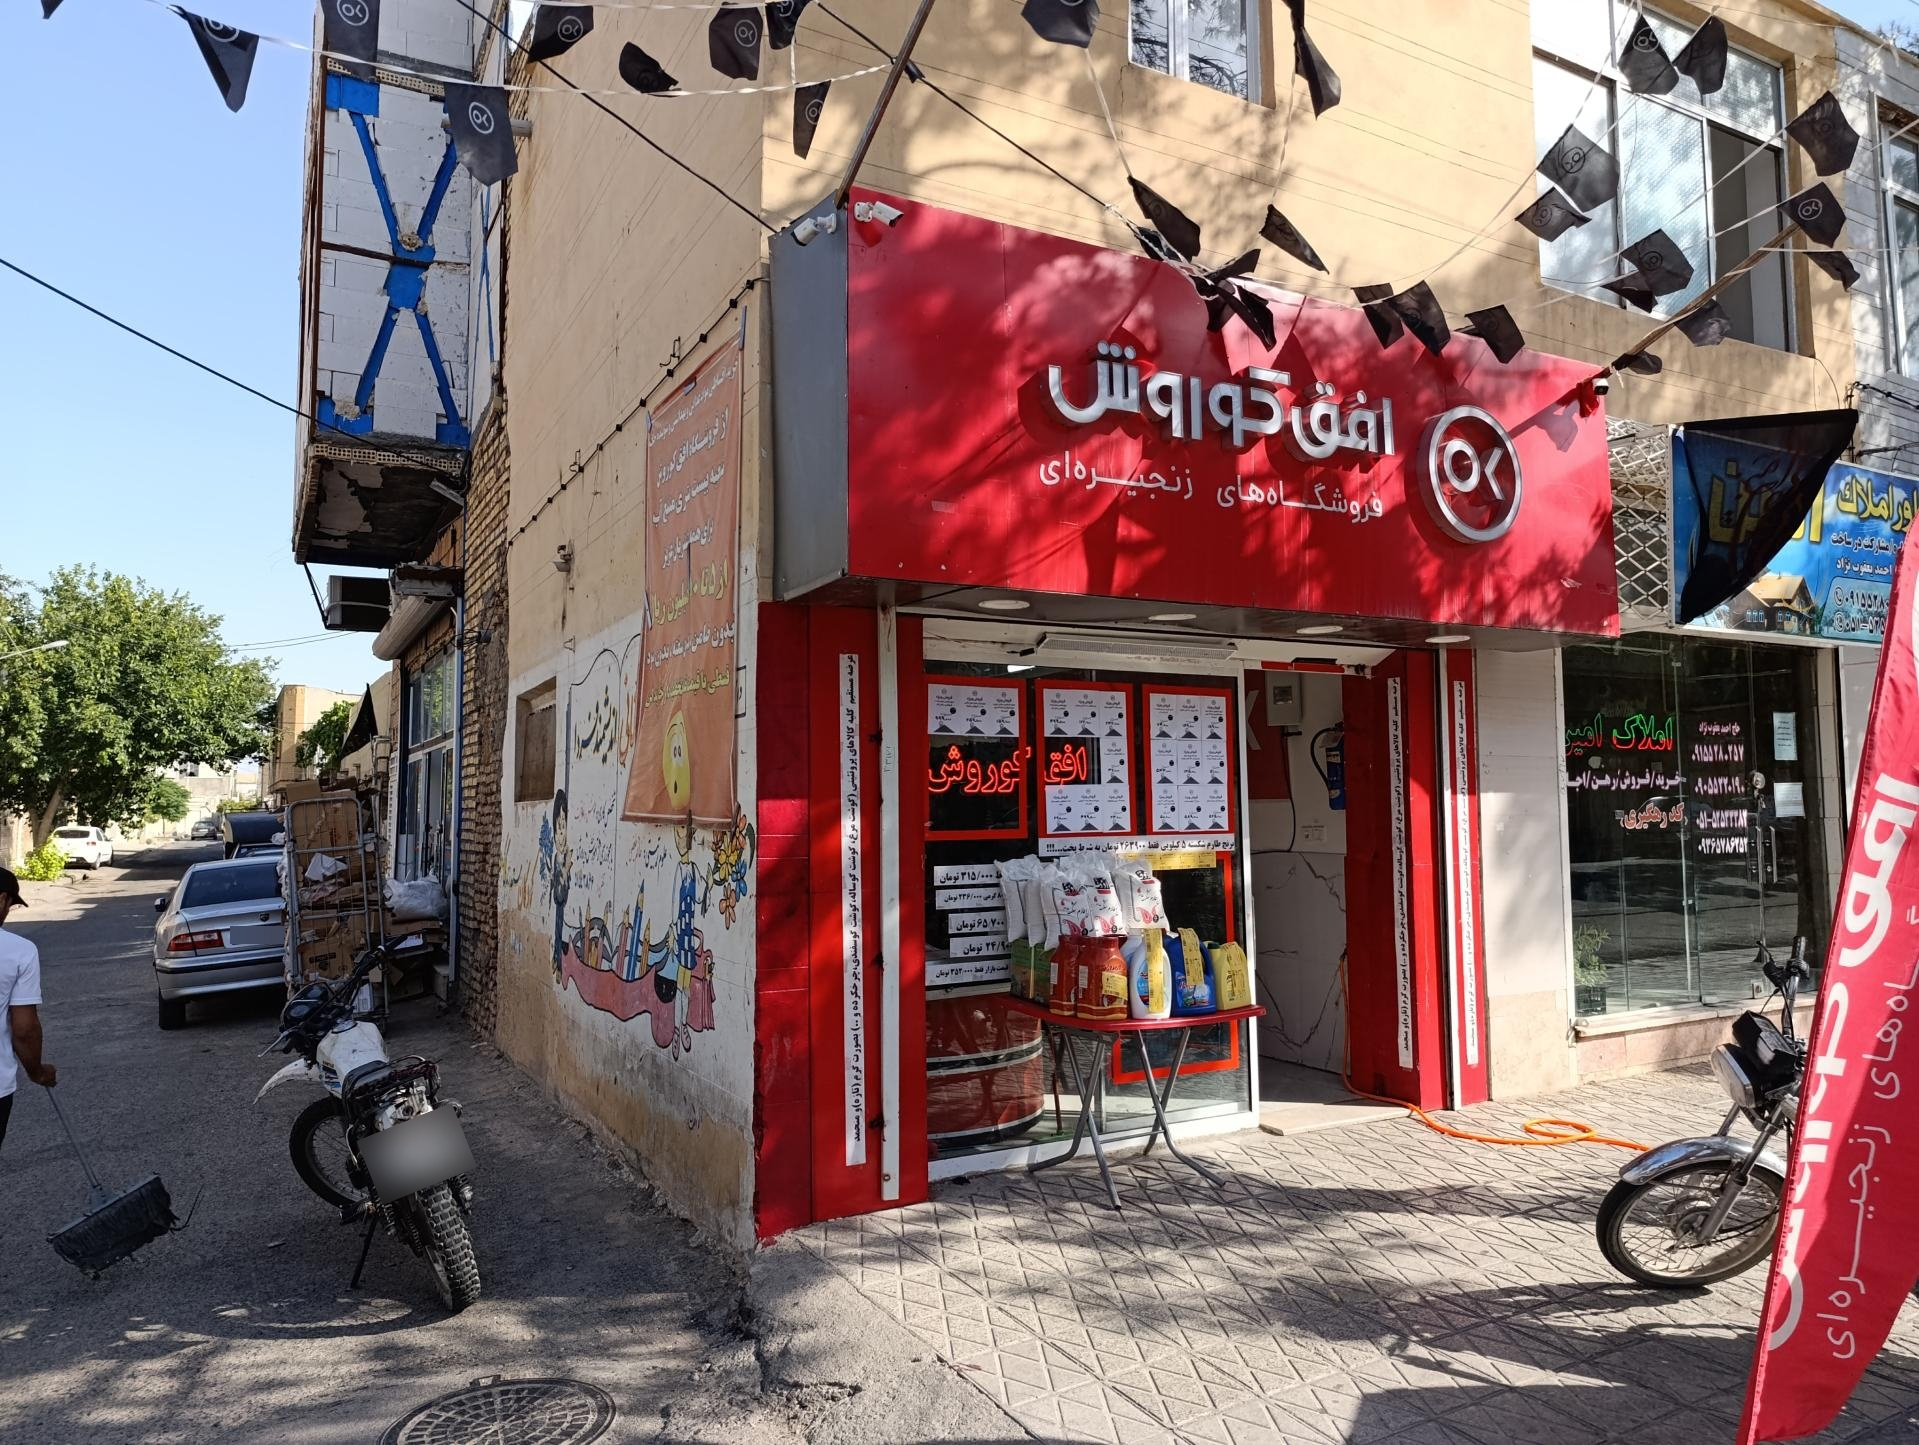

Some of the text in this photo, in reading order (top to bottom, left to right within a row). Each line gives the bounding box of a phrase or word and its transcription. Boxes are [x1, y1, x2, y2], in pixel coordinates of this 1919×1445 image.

[472, 109, 490, 127] OK
[1048, 340, 1395, 460] افق کوروش
[1039, 450, 1384, 525] فروشگاه‌های زنجیره‌ای
[1831, 531, 1852, 548] ساخت
[1836, 556, 1851, 575] نژاد
[846, 656, 856, 676] عرضه
[846, 678, 856, 704] مستقیم
[846, 708, 855, 723] کلیه
[846, 726, 856, 755] کالاهای
[1612, 713, 1674, 751] املاک
[1393, 734, 1401, 756] کالاهای
[1692, 744, 1744, 762] ۰۹۱۵۵۲۸۰۲۵۷
[927, 745, 1032, 793] کوروش
[1043, 743, 1087, 783] افق
[848, 758, 857, 791] پروتئینی
[1102, 844, 1118, 853] تومان
[1120, 840, 1146, 851] ۲۶۳۹۰۰
[1148, 840, 1160, 850] فقط
[1161, 840, 1181, 851] کیلویی
[1188, 839, 1206, 848] شکسته
[1205, 840, 1222, 850] طارم
[848, 846, 857, 870] گوشت
[940, 872, 959, 884] تومان
[960, 871, 992, 882] ۳۱۵/۰۰۰
[944, 894, 958, 902] تومان
[956, 920, 976, 931] تومان
[963, 943, 982, 955] تومان
[936, 970, 950, 978] تومان
[852, 1033, 861, 1062] بصورت
[852, 1065, 862, 1080] گرم
[852, 1115, 861, 1142] منجمد
[1816, 1122, 1893, 1360] زنجیره‌ای
